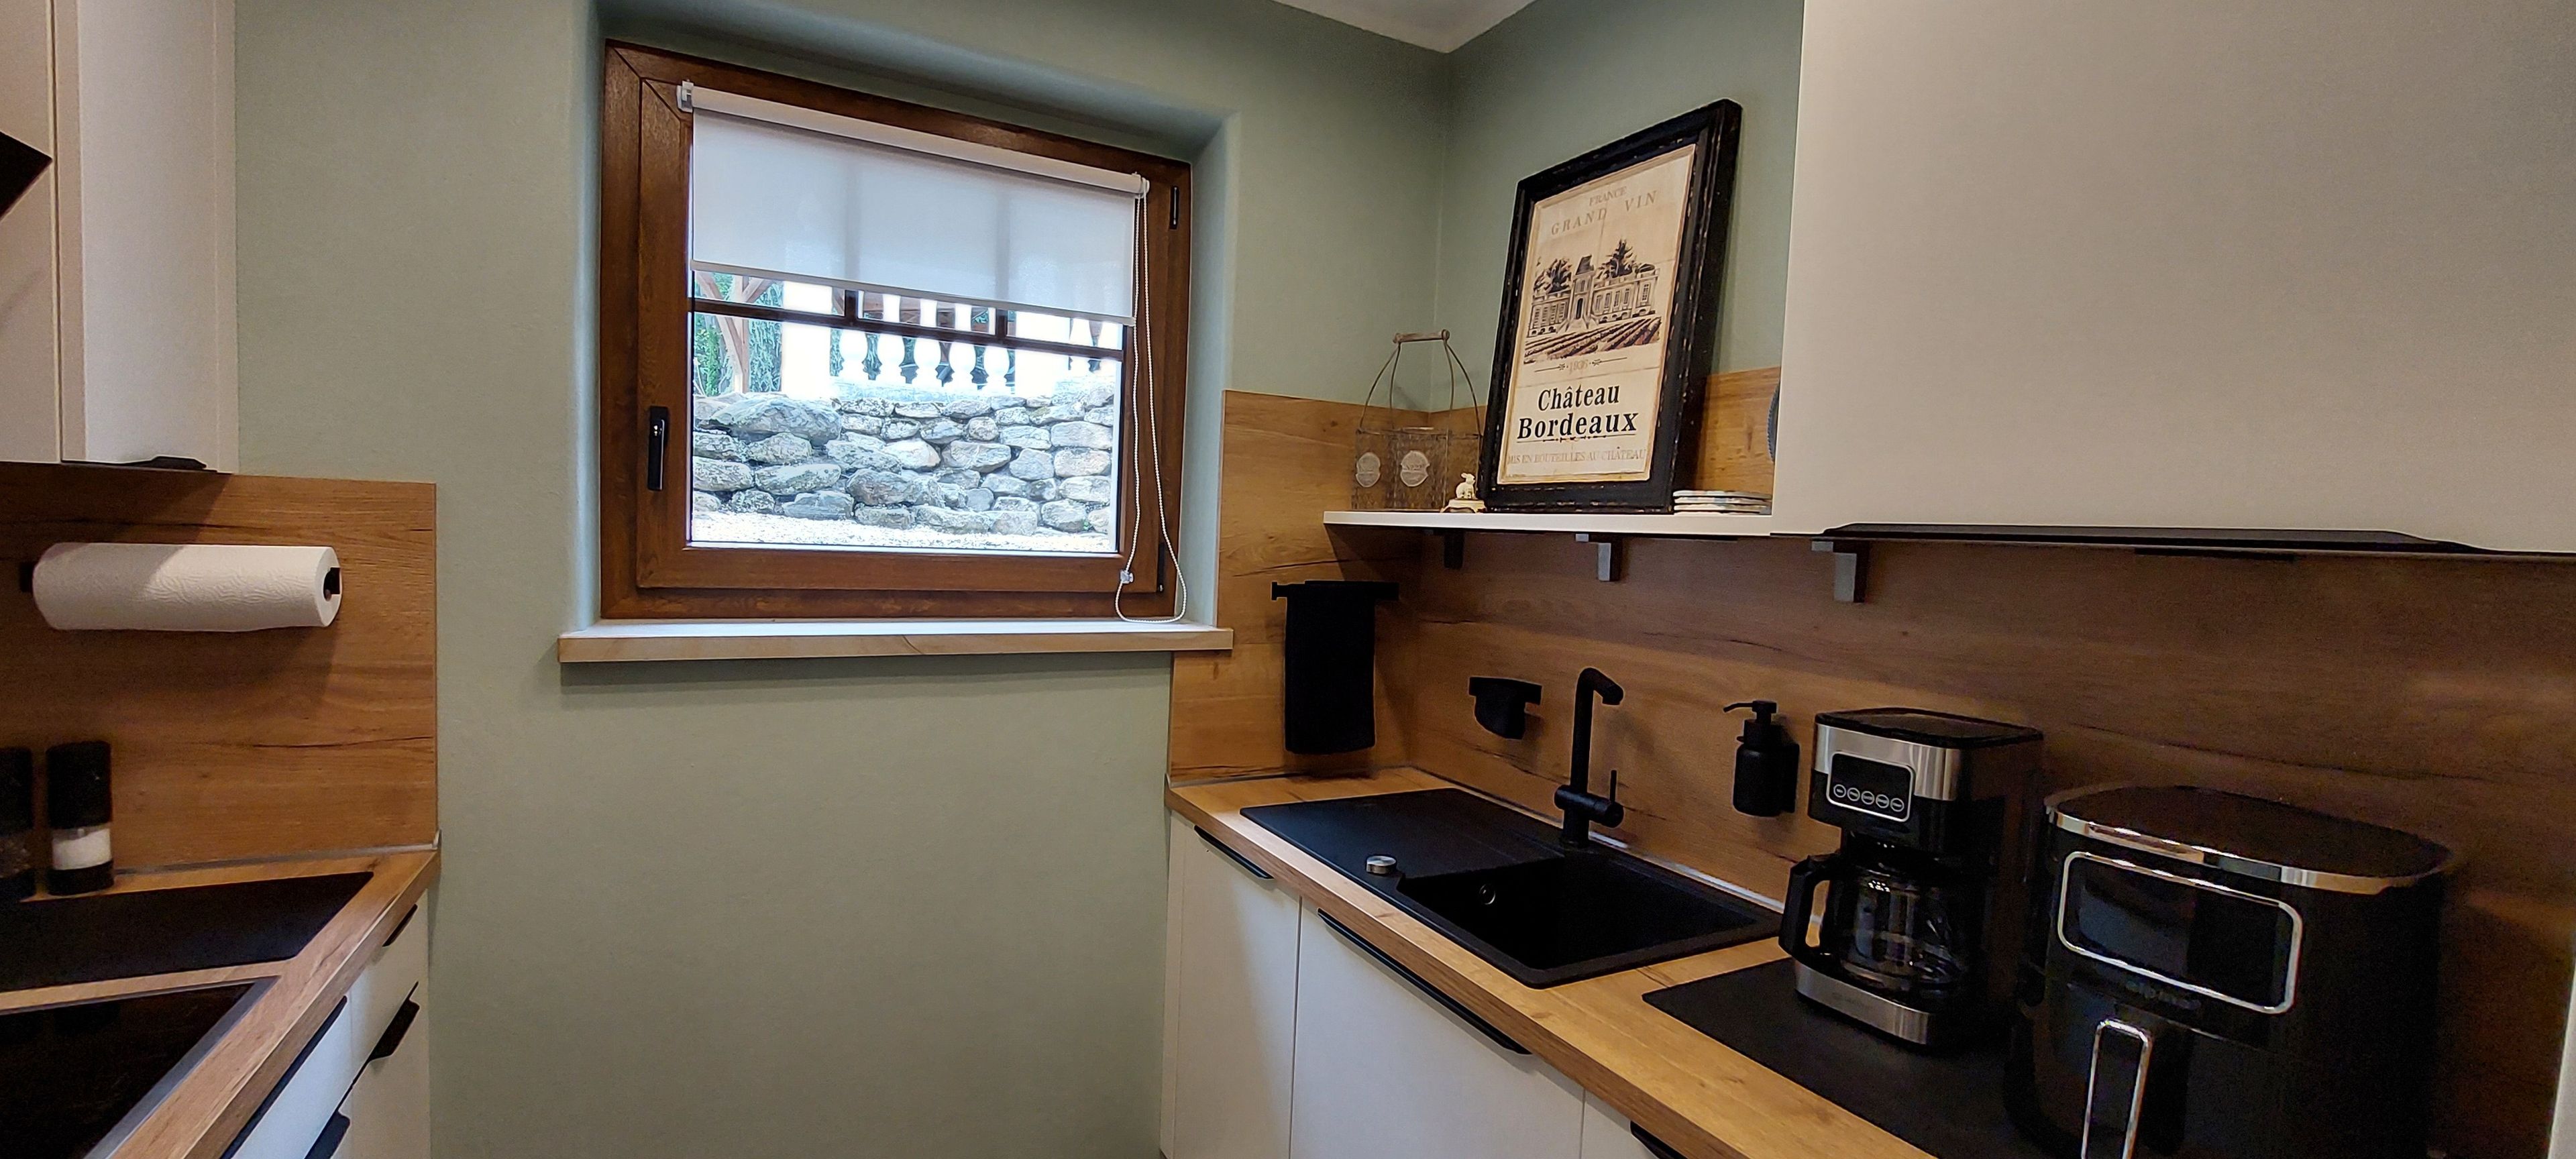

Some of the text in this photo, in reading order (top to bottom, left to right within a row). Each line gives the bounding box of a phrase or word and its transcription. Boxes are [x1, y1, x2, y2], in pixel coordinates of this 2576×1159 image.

[1589, 186, 1627, 207] FRANCE
[1551, 190, 1658, 235] GRAND VIN
[1538, 384, 1620, 411] Château
[1517, 412, 1639, 439] Bordeaux
[1534, 451, 1586, 463] BOUTEILLES
